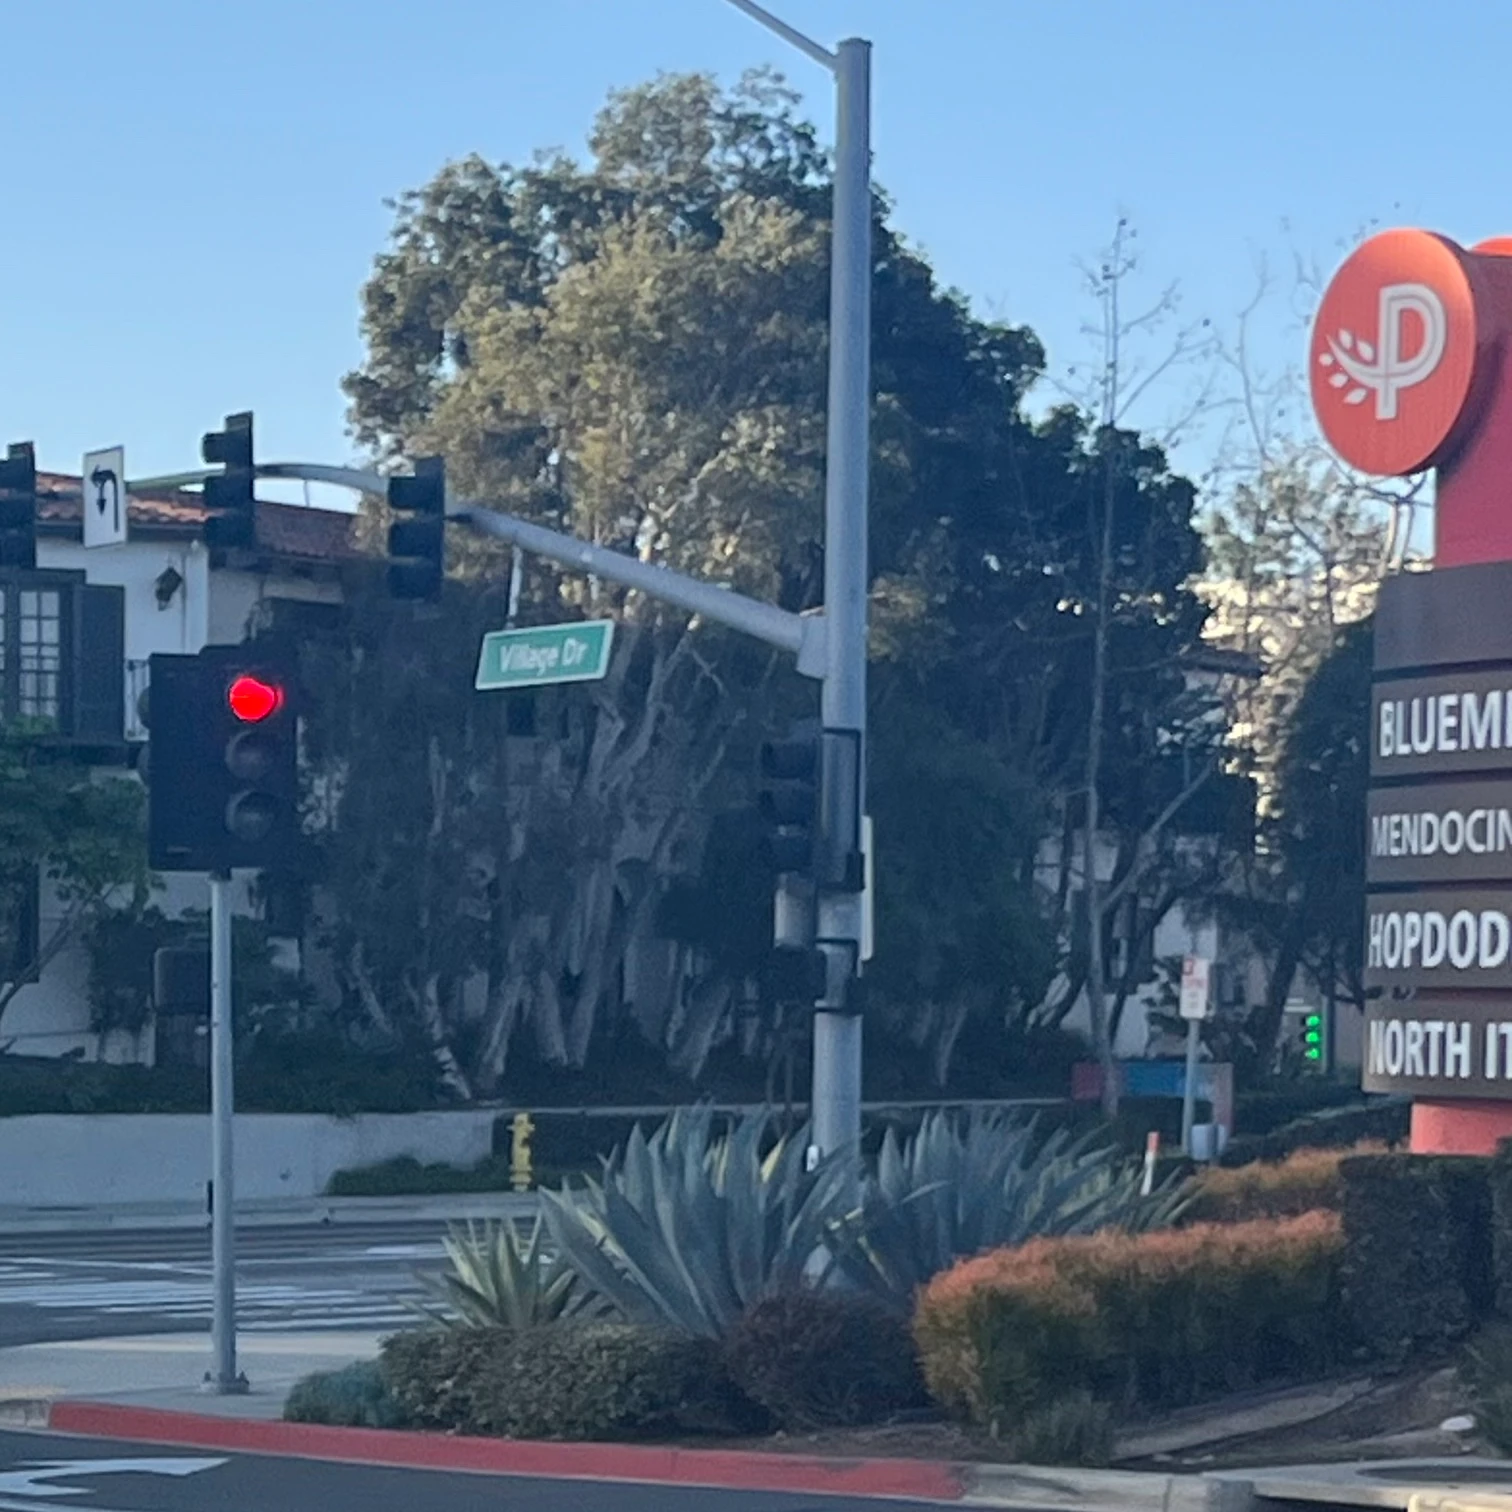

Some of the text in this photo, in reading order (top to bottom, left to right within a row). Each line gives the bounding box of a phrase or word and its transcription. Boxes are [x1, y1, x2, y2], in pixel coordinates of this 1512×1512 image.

[500, 637, 588, 677] Village Dr
[1371, 808, 1512, 857] MENDOCIN
[1368, 909, 1510, 969] HOPDOD
[1368, 1018, 1471, 1078] NORTH
